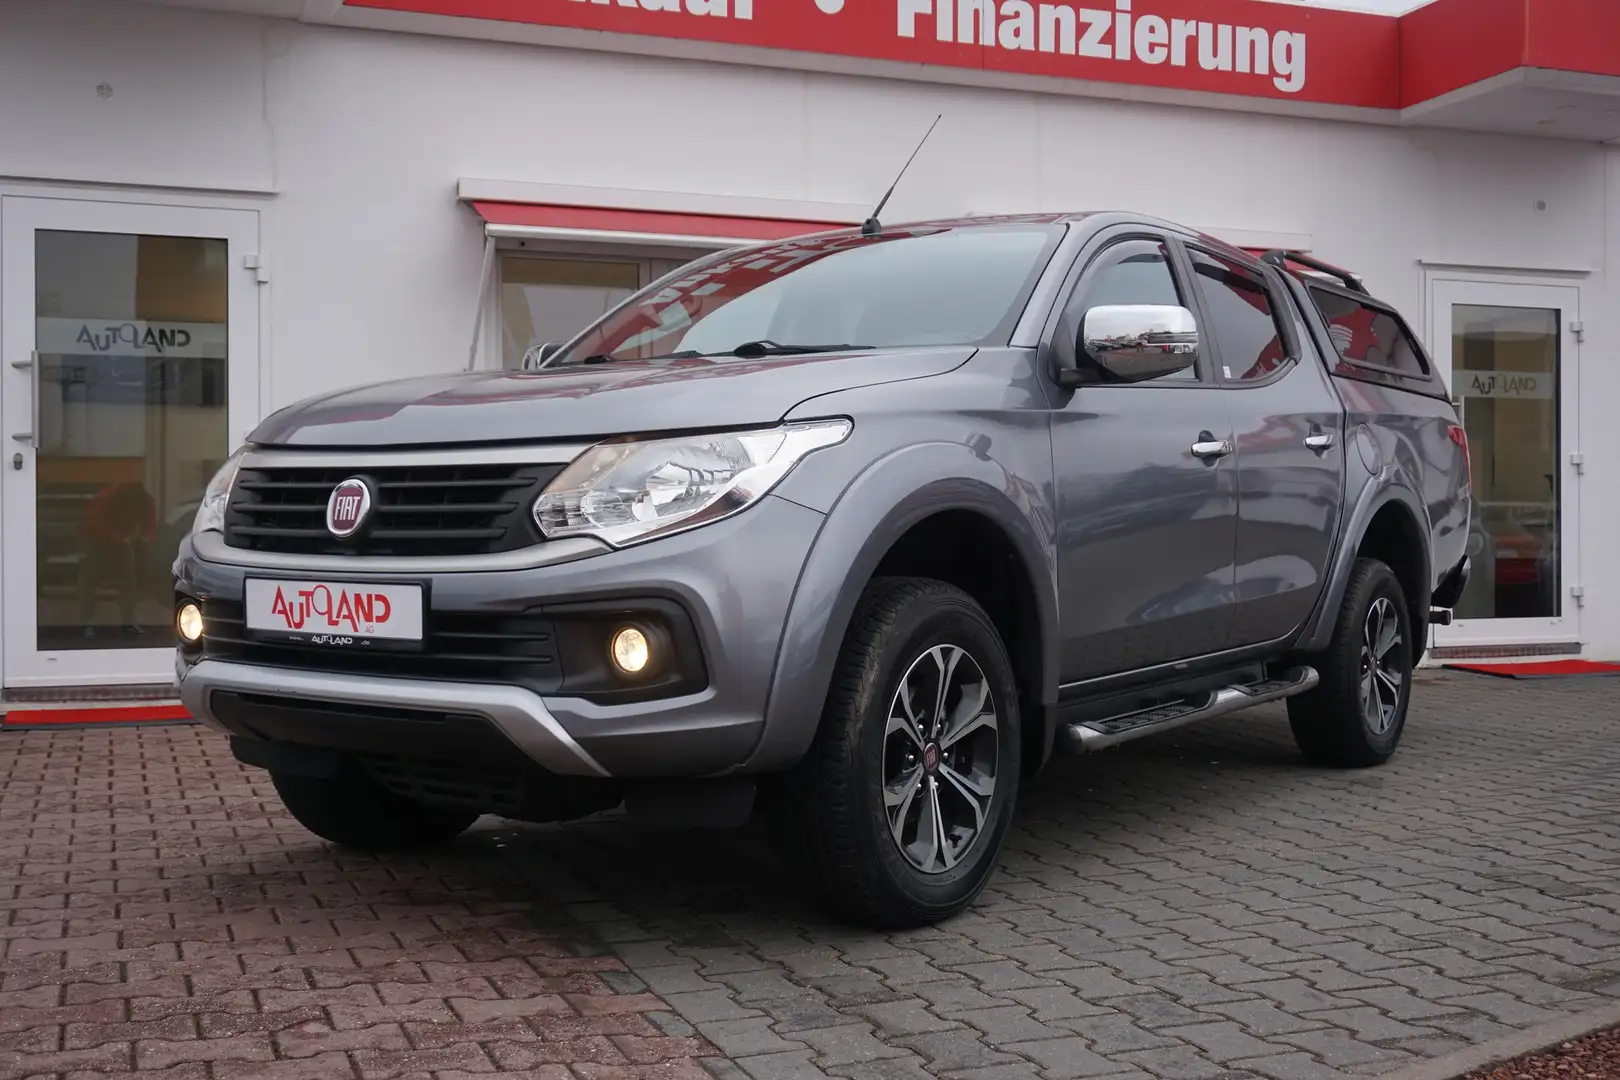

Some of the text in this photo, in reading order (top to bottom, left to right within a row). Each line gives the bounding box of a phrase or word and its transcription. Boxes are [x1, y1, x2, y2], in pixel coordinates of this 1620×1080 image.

[76, 323, 191, 353] AUTOLAND
[334, 496, 361, 520] FIAT
[272, 584, 392, 633] AUTOLAND
[311, 635, 353, 645] AUTOLAND
